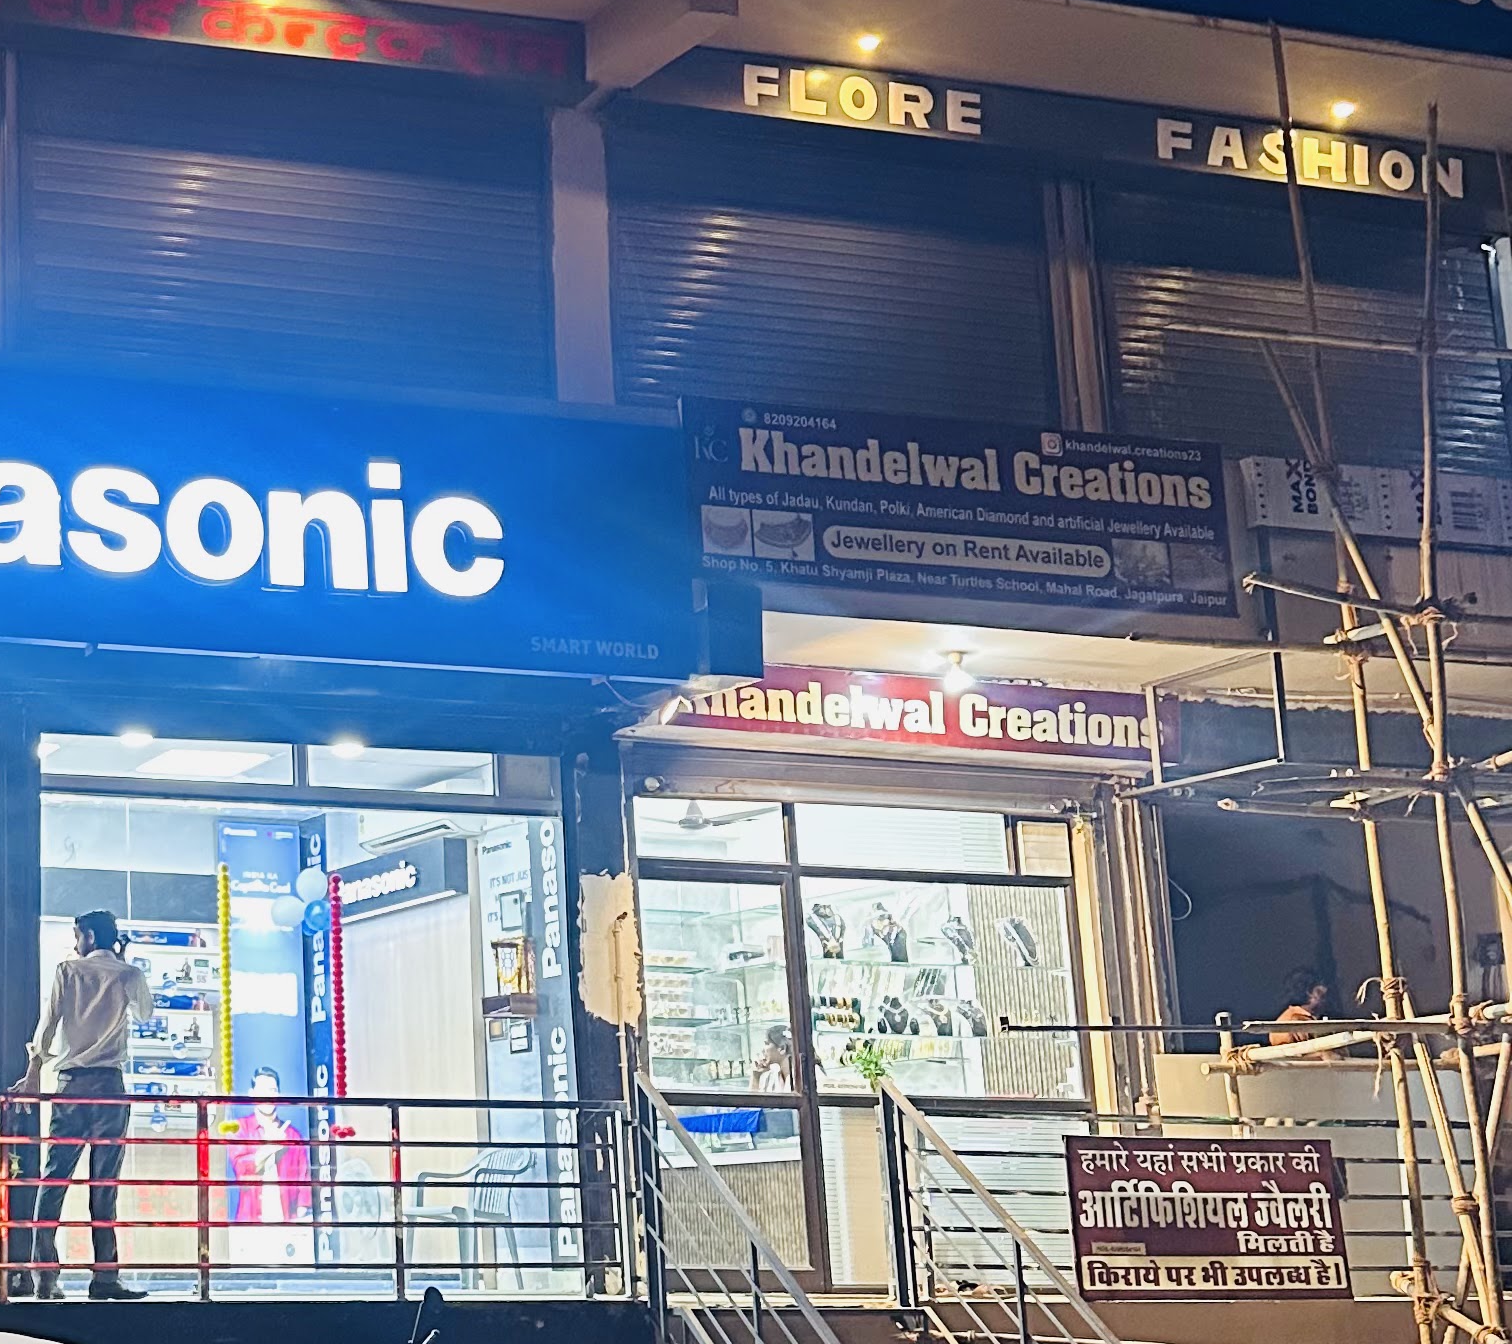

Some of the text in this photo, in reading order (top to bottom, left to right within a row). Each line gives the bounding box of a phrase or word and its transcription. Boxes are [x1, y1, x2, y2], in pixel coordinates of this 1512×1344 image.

[742, 62, 1464, 200] FLORE FASHION
[763, 411, 837, 429] 8209204164
[738, 427, 1212, 510] Khandelwal Creations
[708, 485, 726, 501] All
[728, 488, 763, 506] types
[766, 491, 780, 506] of
[826, 496, 878, 514] Kundan,
[916, 503, 973, 521] American
[976, 509, 1029, 526] Diamond
[1032, 512, 1056, 527] and
[1057, 515, 1104, 533] artificial
[1107, 518, 1161, 540] Jewellery
[1163, 522, 1215, 540] Available
[831, 531, 1105, 569] Jewellery on Rent Available
[702, 556, 737, 572] Shop
[821, 563, 873, 582] Shyamji
[918, 571, 947, 585] Near
[996, 577, 1043, 595] School,
[1046, 581, 1083, 596] Mahal
[1190, 592, 1227, 607] Jaipur
[530, 636, 659, 660] SMART WORLD
[688, 683, 1165, 750] handelwal Creations
[482, 839, 512, 855] Panasonic
[339, 859, 417, 905] anasonic
[1077, 1140, 1321, 1176] हमारे यहां सभी प्रकार की
[1078, 1177, 1333, 1229] आर्टिफिशियल ज्वैलरी
[1237, 1229, 1336, 1253] मिलती है
[1088, 1259, 1161, 1287] किराये
[1165, 1265, 1198, 1287] पर
[1201, 1260, 1228, 1287] भी
[1231, 1264, 1311, 1288] उपलब्ध
